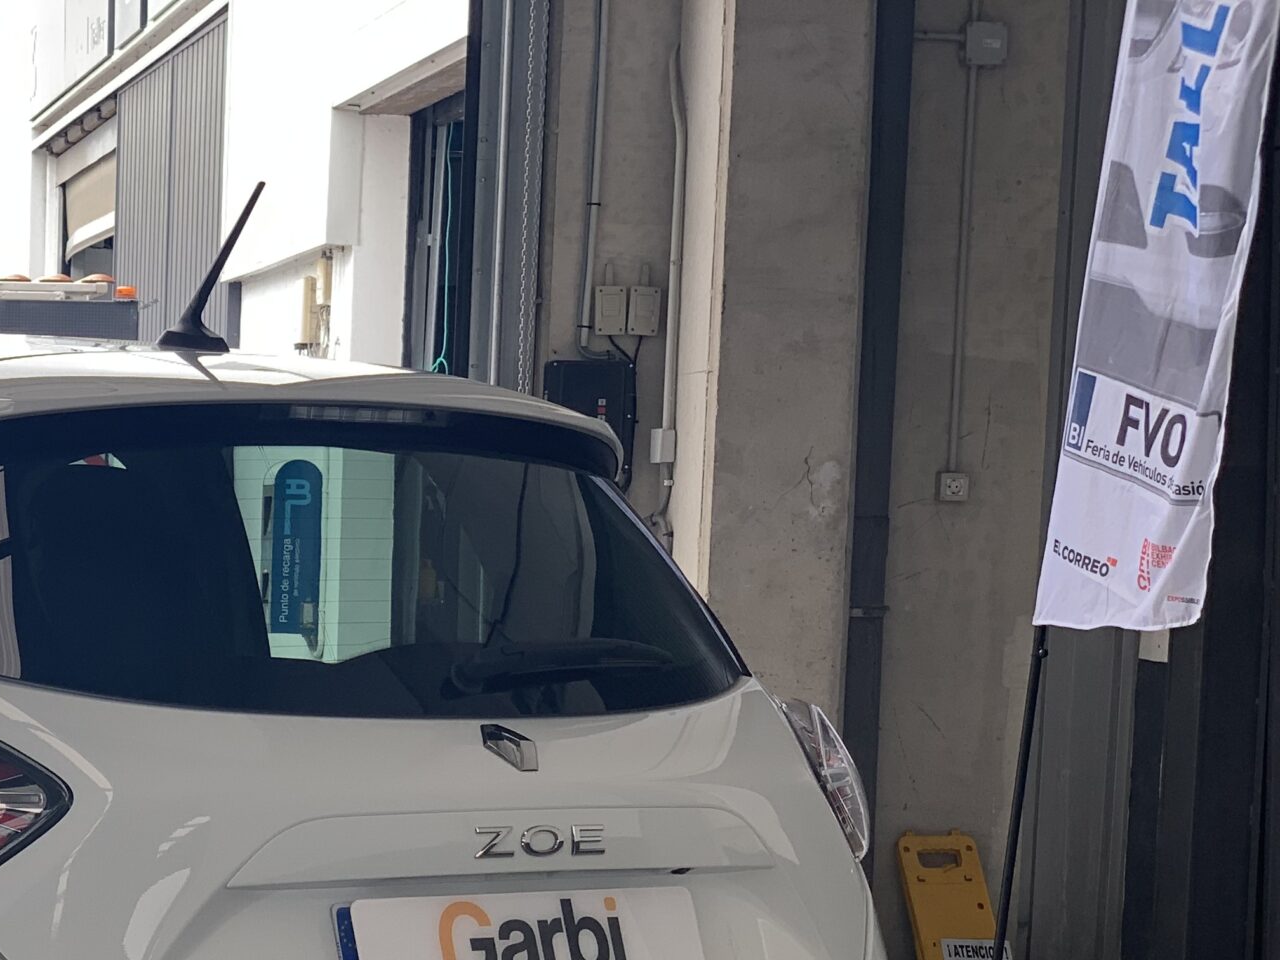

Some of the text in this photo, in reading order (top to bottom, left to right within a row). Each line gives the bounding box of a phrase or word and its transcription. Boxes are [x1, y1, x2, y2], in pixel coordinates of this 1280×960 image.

[1068, 422, 1085, 447] BI
[1116, 393, 1187, 468] FVO
[1084, 439, 1110, 461] Feria
[1111, 451, 1125, 467] de
[1061, 545, 1110, 577] CORREO
[279, 538, 294, 623] Punto de recarga
[473, 823, 606, 860] ZOE
